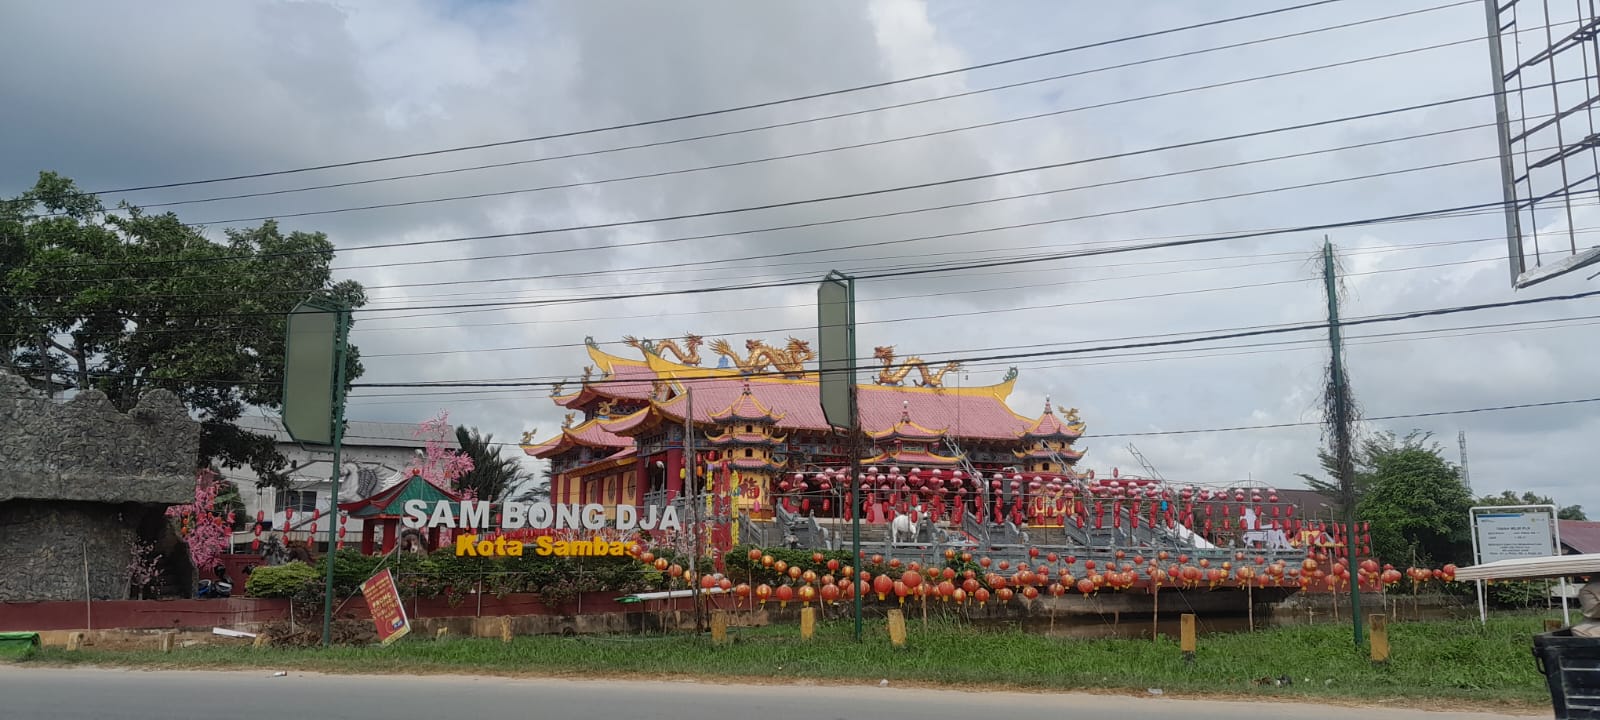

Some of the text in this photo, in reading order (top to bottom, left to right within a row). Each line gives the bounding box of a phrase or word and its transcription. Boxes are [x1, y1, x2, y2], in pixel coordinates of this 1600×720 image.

[403, 500, 680, 532] SAM BONG DJA
[456, 534, 523, 556] Kota
